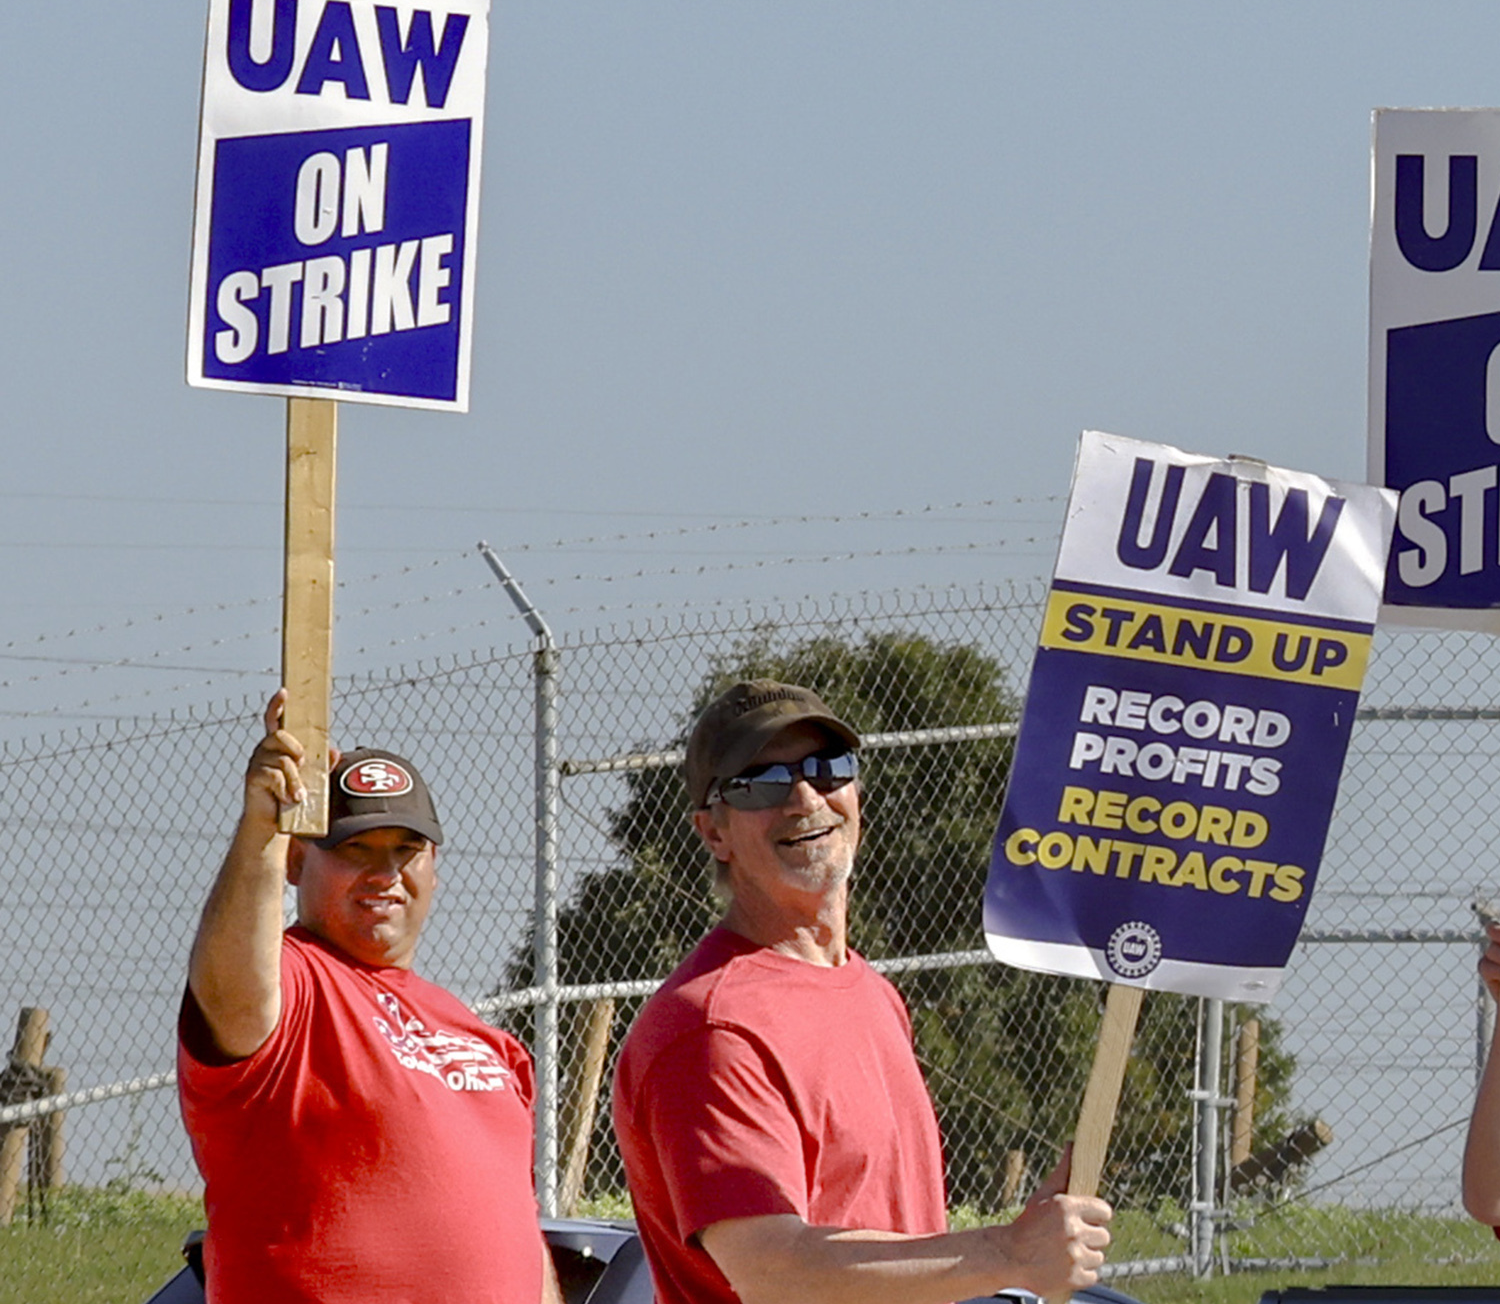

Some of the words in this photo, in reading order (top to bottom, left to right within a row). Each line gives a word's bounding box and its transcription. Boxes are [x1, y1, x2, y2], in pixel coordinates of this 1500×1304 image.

[294, 143, 388, 246] ON
[215, 234, 453, 364] STRIKE
[1116, 458, 1345, 601] UAW
[1060, 604, 1254, 664] STAND
[1271, 635, 1348, 677] UP
[1080, 685, 1291, 748] RECORD
[359, 763, 400, 791] SF
[1070, 733, 1282, 795] PROFITS
[1057, 787, 1269, 849] RECORD
[1004, 829, 1305, 904] CONTRACTS
